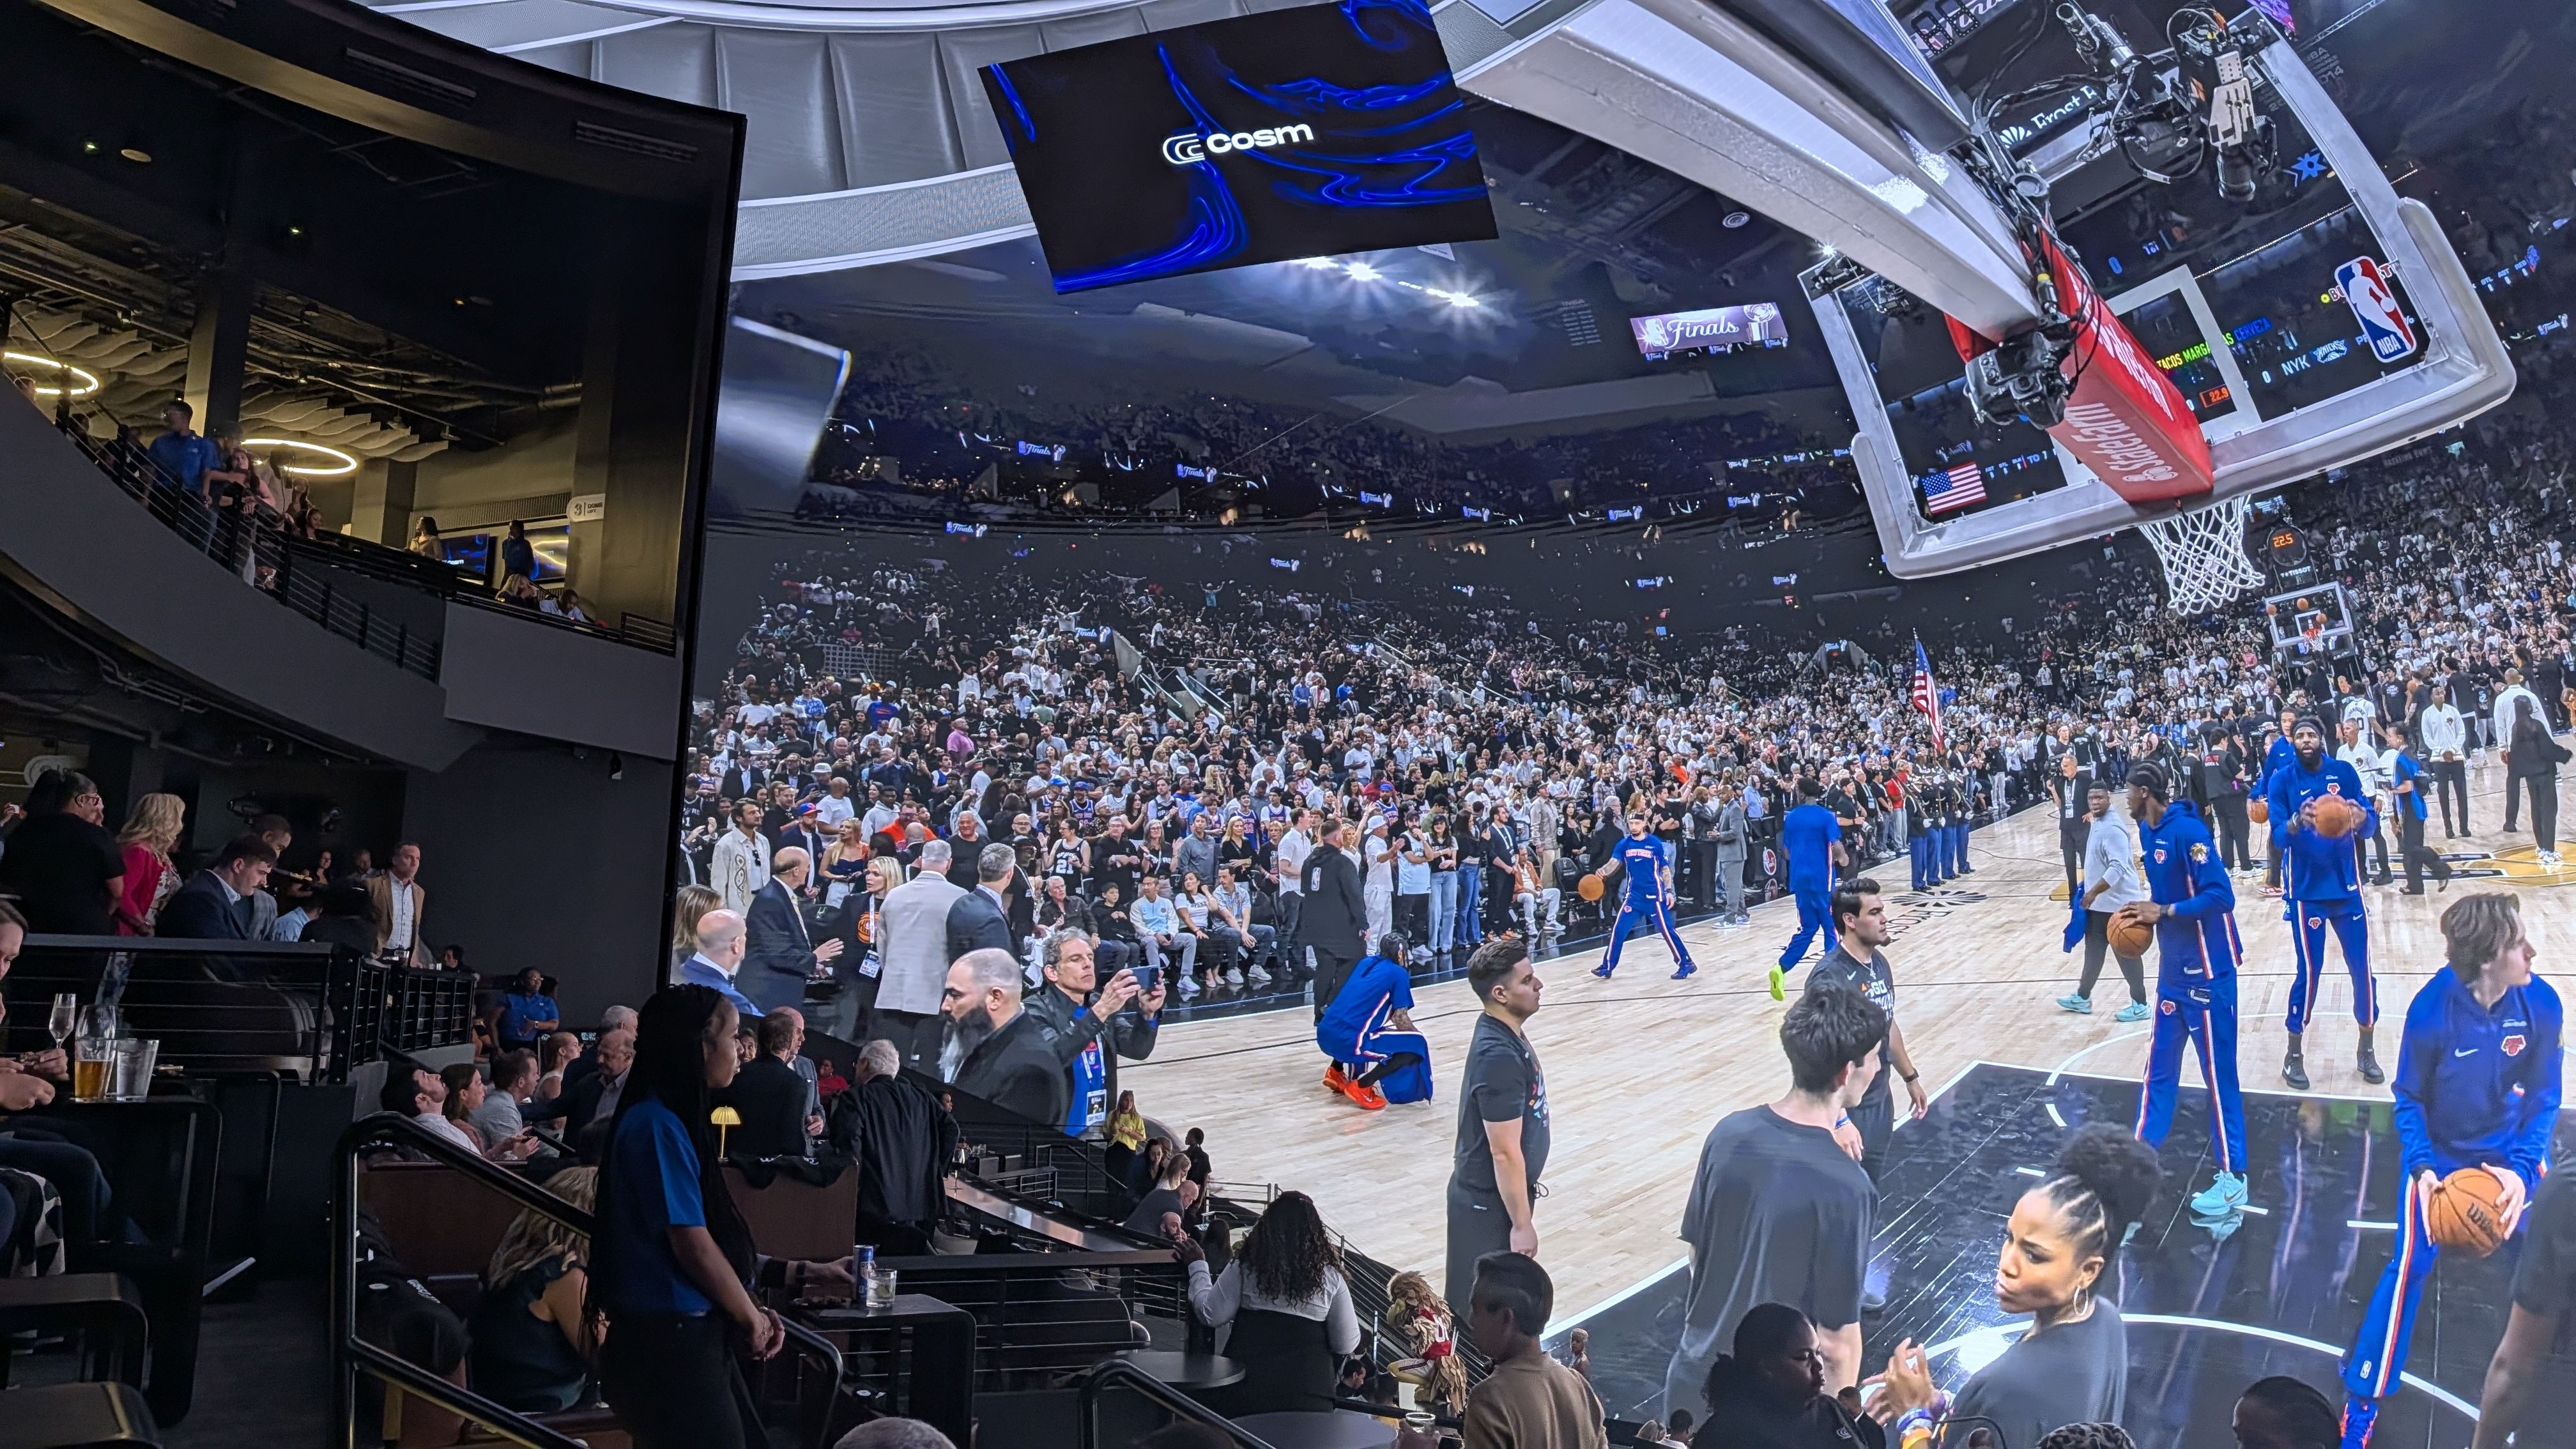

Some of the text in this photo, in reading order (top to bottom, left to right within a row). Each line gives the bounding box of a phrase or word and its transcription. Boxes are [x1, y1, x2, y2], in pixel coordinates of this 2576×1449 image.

[1666, 316, 1740, 350] Finals
[2234, 318, 2271, 341] CERVEZA
[2376, 334, 2402, 356] NBA
[2209, 387, 2229, 402] 22.9
[2261, 370, 2272, 384] 0
[2281, 355, 2312, 376] NYK
[1026, 444, 1051, 456] Finals
[1183, 466, 1205, 478] Finals
[574, 503, 582, 516] 3
[1613, 510, 1632, 520] Finals
[952, 522, 974, 533] Finals
[2272, 533, 2296, 548] 22.5
[2288, 565, 2312, 576] TISSOT
[1075, 627, 1098, 638] Finals
[1244, 824, 1255, 833] 32
[1055, 859, 1074, 875] 21
[1871, 979, 1888, 995] GO
